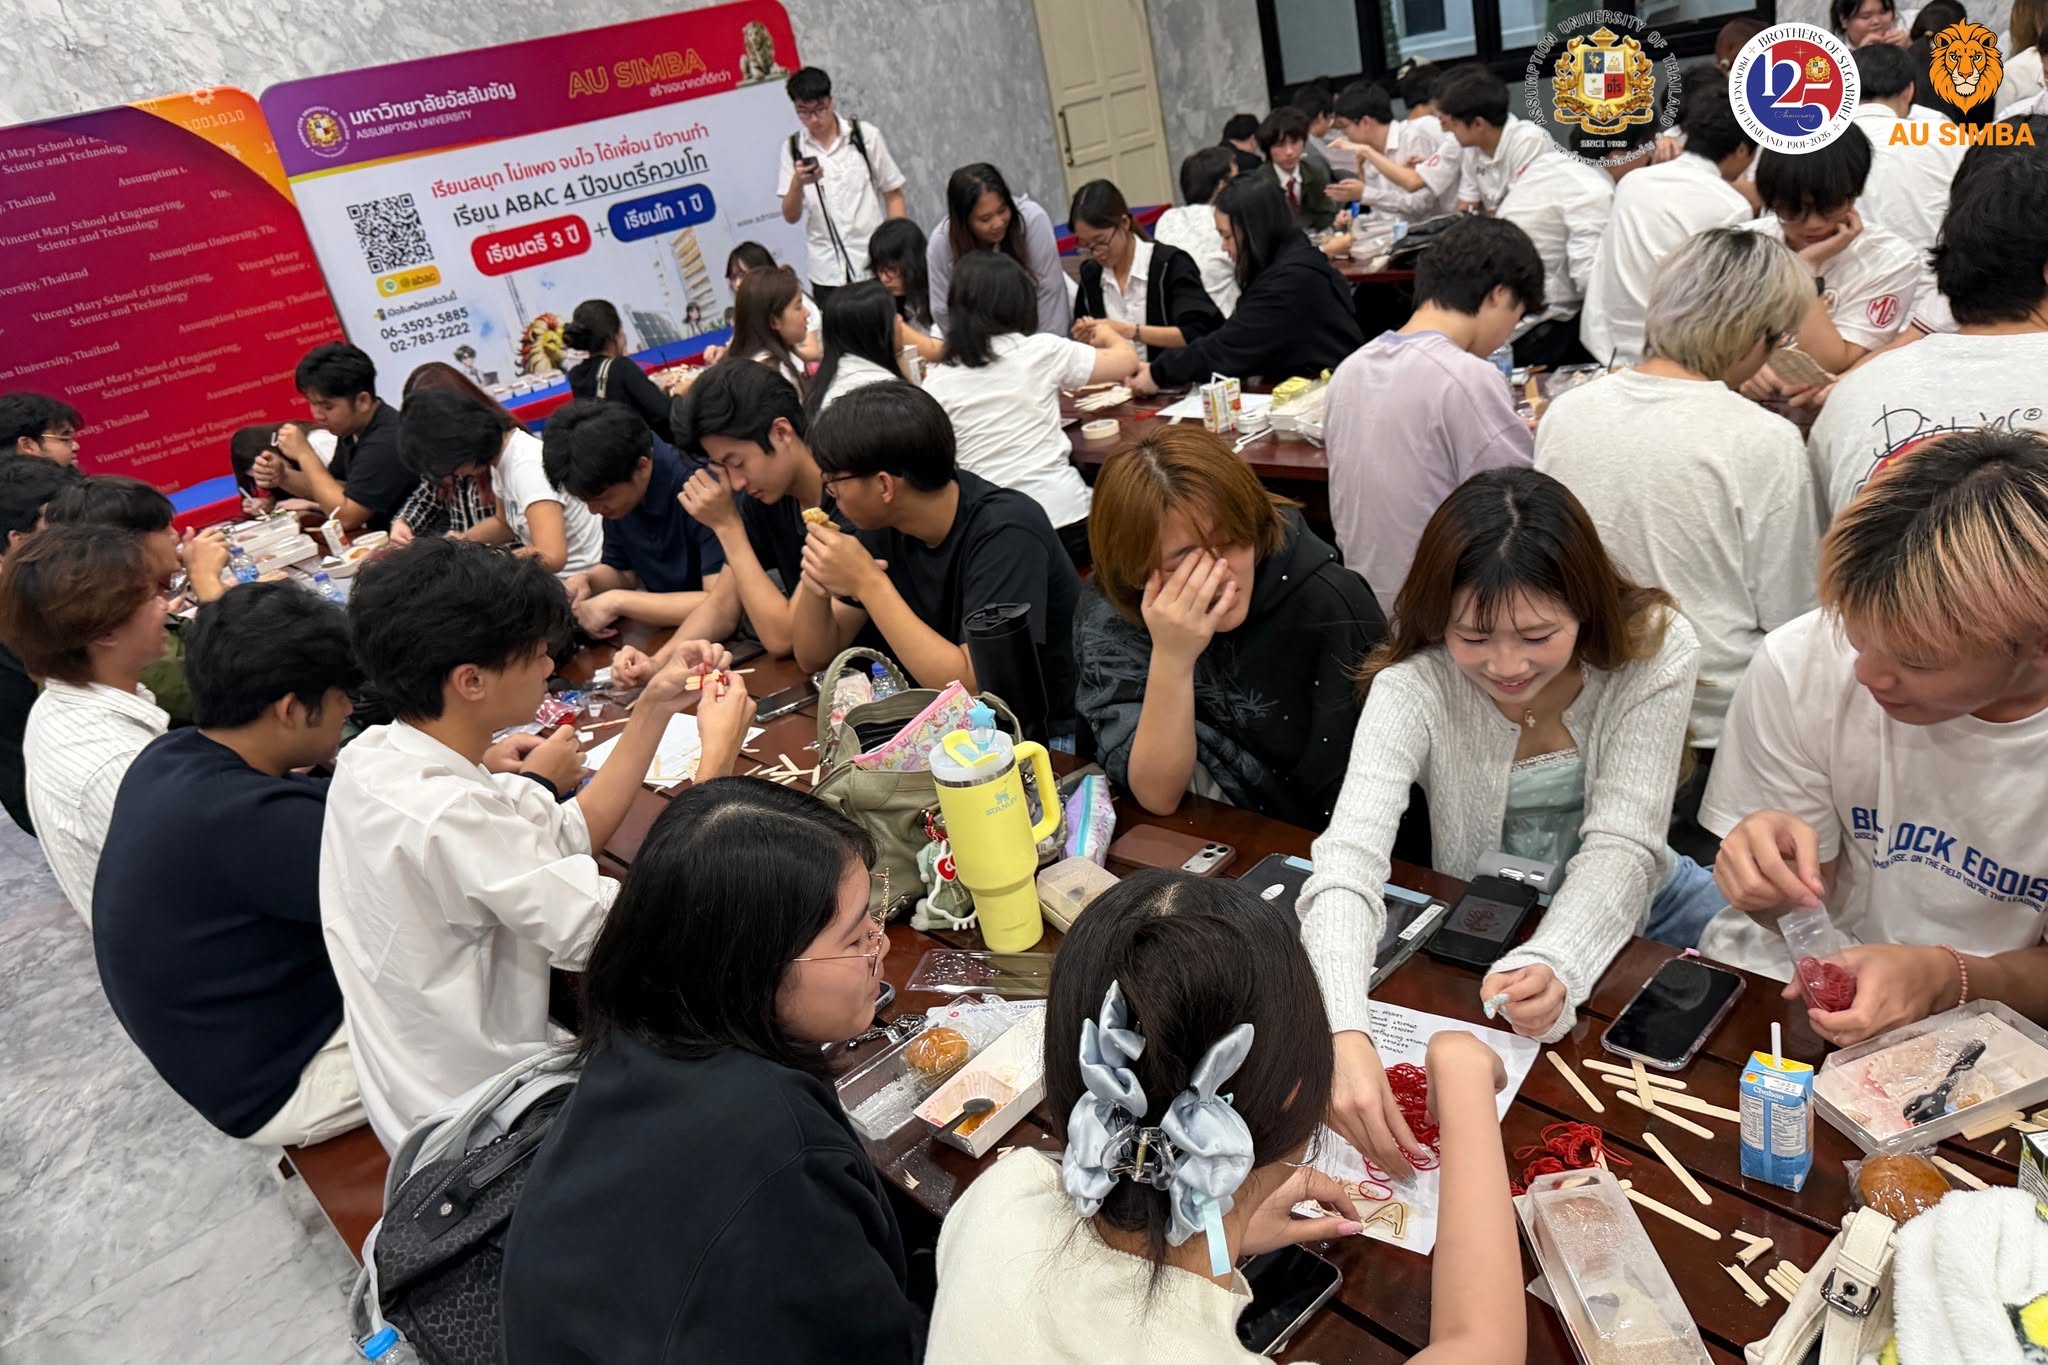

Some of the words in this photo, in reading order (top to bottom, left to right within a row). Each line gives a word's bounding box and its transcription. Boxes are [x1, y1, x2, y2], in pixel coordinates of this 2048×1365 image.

[568, 66, 609, 99] AU
[613, 48, 707, 88] SIMBA
[349, 82, 517, 125] มหาวิทยาลัยอัสสัมชัญ
[356, 119, 418, 139] ASSUMPTION
[418, 110, 472, 129] UNIVERSITY
[2, 158, 44, 175] Science
[46, 154, 68, 167] and
[67, 144, 128, 162] Technology
[8, 147, 36, 161] Mary
[38, 138, 74, 153] School
[75, 135, 87, 146] of
[431, 170, 505, 199] เรียนสนุก
[504, 160, 556, 182] ไม่แพง
[559, 147, 595, 170] จบไว
[594, 135, 652, 162] ได้เพื่อน
[653, 122, 710, 149] มีงานทำ
[117, 168, 179, 187] Assumption
[453, 203, 501, 227] เรียน
[505, 187, 559, 216] ABAC
[563, 182, 577, 201] 4
[578, 146, 708, 197] ปีจบตรีควบโท
[7, 192, 57, 211] Thailand
[0, 231, 41, 247] Vincent
[42, 224, 70, 239] Mary
[71, 214, 107, 231] School
[108, 212, 120, 223] of
[119, 200, 186, 221] Engineering,
[37, 236, 79, 253] Science
[80, 231, 100, 244] and
[99, 219, 160, 238] Technology
[486, 231, 548, 265] เรียนตรี
[551, 231, 564, 248] 3
[564, 223, 581, 244] ปี
[623, 202, 675, 231] เรียนโท
[677, 200, 687, 216] 1
[689, 192, 704, 212] ปี
[149, 239, 207, 261] Assumption
[208, 228, 260, 247] University,
[238, 258, 274, 272] Vincent
[275, 251, 299, 265] Mary
[270, 262, 305, 278] Science
[0, 280, 40, 297] versity,
[40, 267, 89, 287] Thailand
[32, 304, 75, 323] Vincent
[75, 298, 103, 312] Mary
[103, 289, 139, 305] School
[140, 286, 150, 297] of
[69, 310, 109, 328] Science
[111, 305, 132, 318] and
[132, 292, 189, 312] Technology
[178, 313, 236, 335] Assumption
[380, 307, 469, 340] 06-3593-5885
[390, 322, 471, 353] 02-783-2222
[14, 354, 74, 377] University,
[72, 341, 121, 361] Thailand
[64, 378, 106, 396] Vincent
[106, 371, 132, 385] Mary
[133, 360, 168, 378] School
[169, 357, 181, 368] of
[101, 381, 141, 400] Science
[142, 377, 161, 389] and
[161, 362, 217, 383] Technology
[72, 424, 104, 440] ersity,
[104, 409, 149, 430] Thailand
[96, 446, 134, 463] Vincent
[135, 439, 161, 453] Mary
[162, 430, 195, 445] School
[197, 424, 207, 434] of
[131, 448, 168, 466] Science
[170, 443, 189, 454] and
